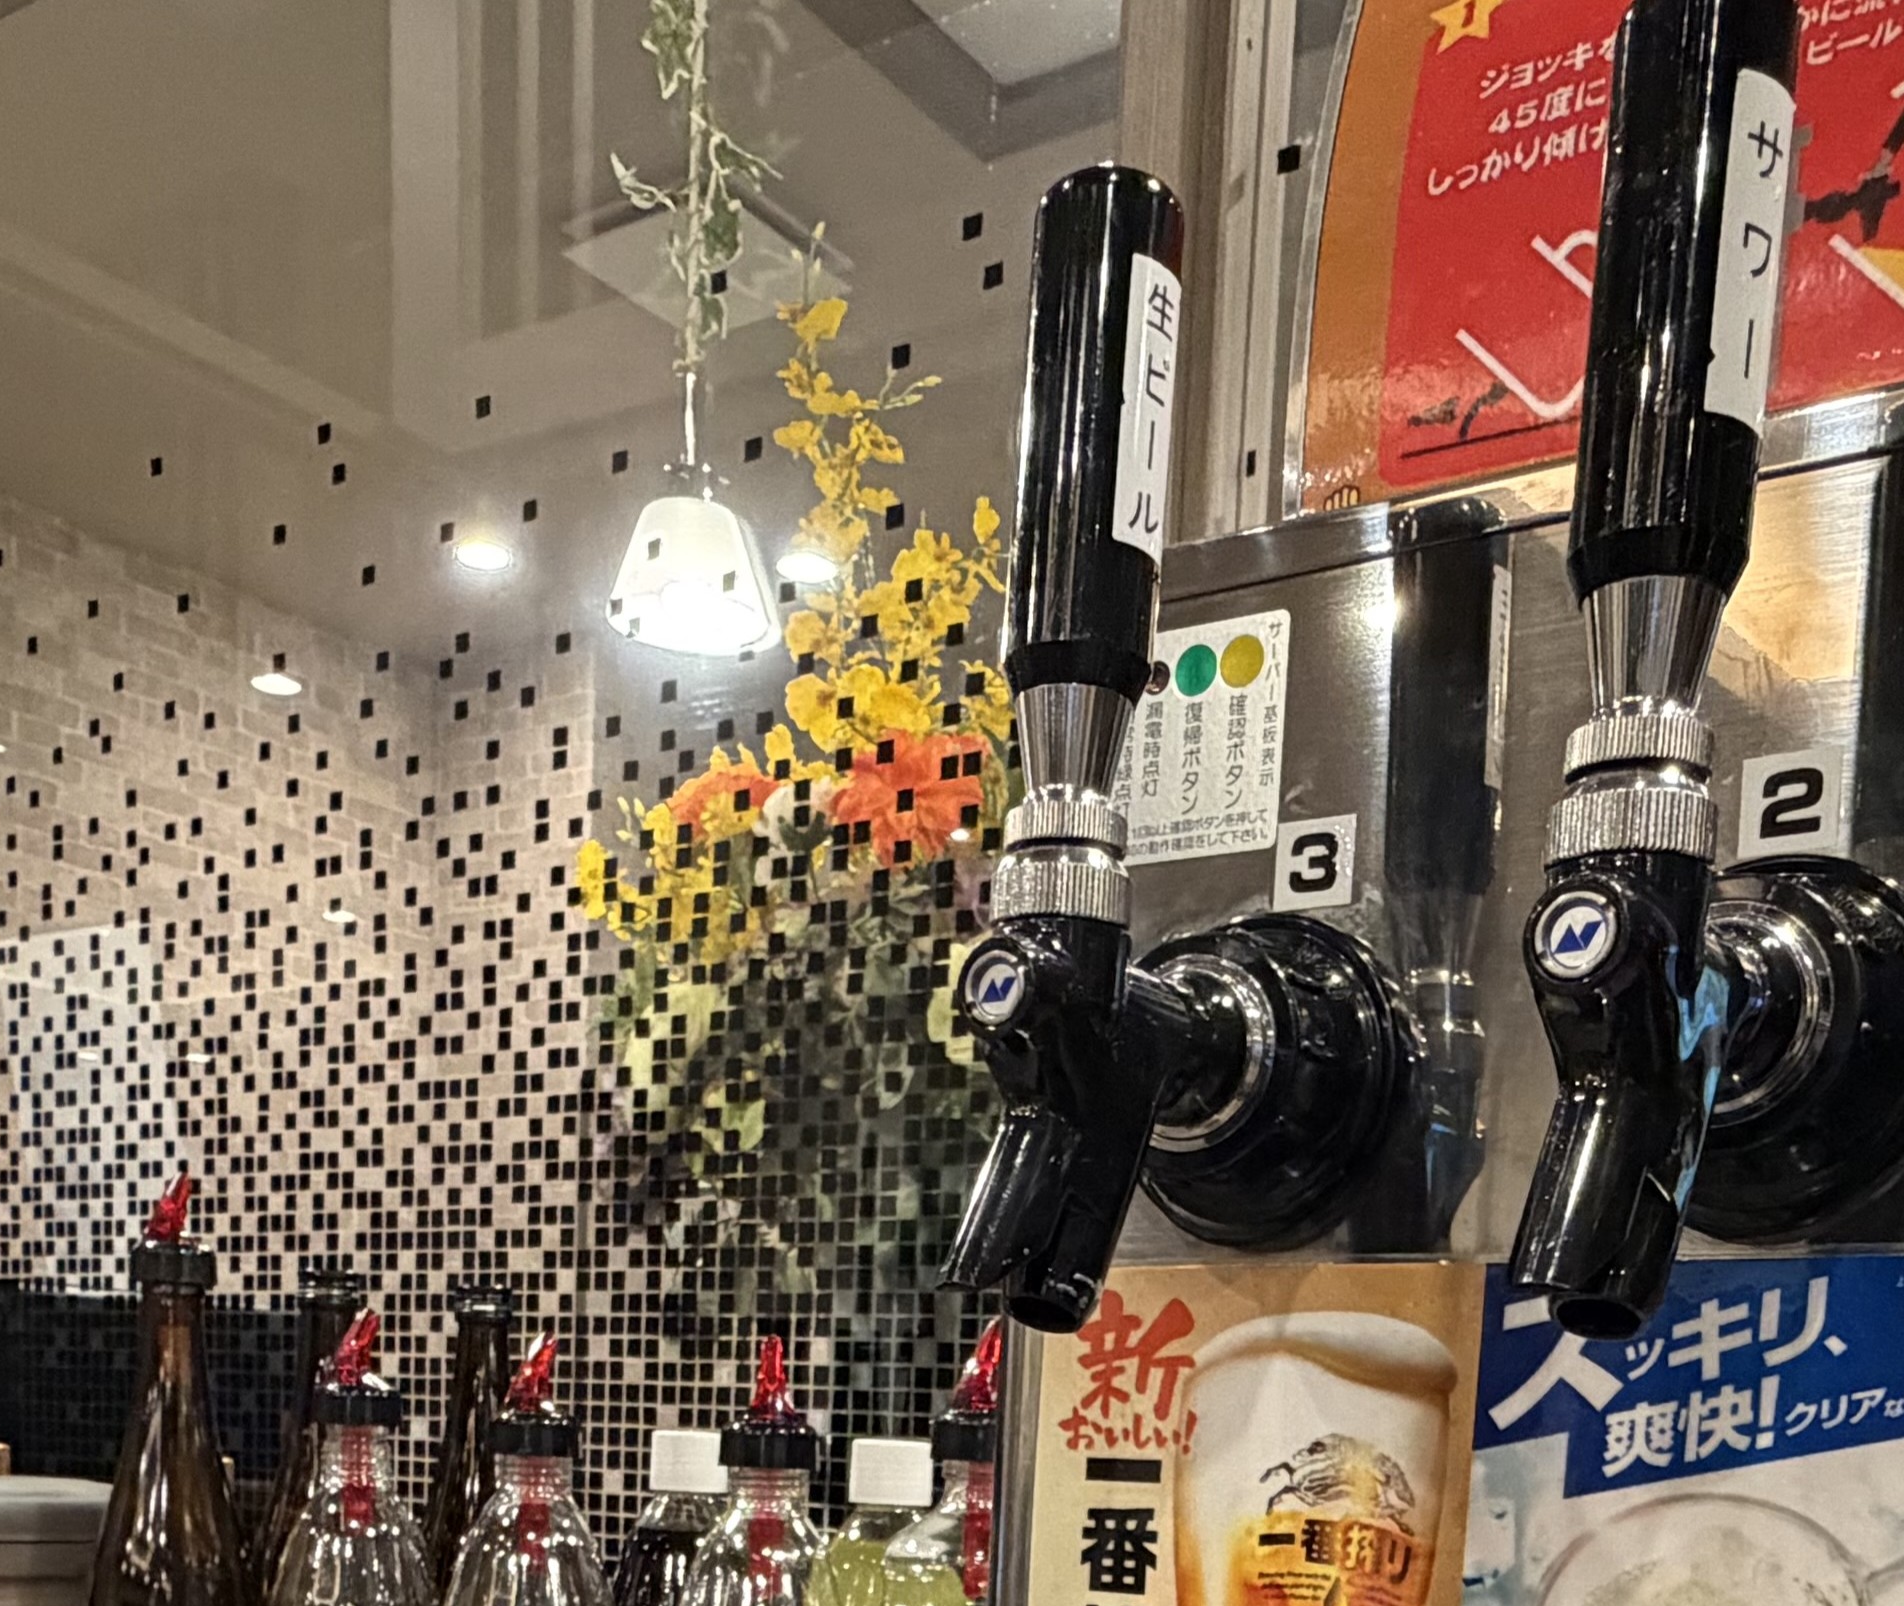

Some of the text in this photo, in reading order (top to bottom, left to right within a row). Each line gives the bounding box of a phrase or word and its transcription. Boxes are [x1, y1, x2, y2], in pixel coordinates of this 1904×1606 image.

[1488, 78, 1607, 134] 45度に
[1743, 120, 1784, 380] サワー
[1129, 283, 1174, 535] 生ビール
[1225, 693, 1248, 810] 確認ボタン
[1758, 766, 1824, 841] 2
[1288, 831, 1341, 895] 3
[1075, 1288, 1197, 1422] 新
